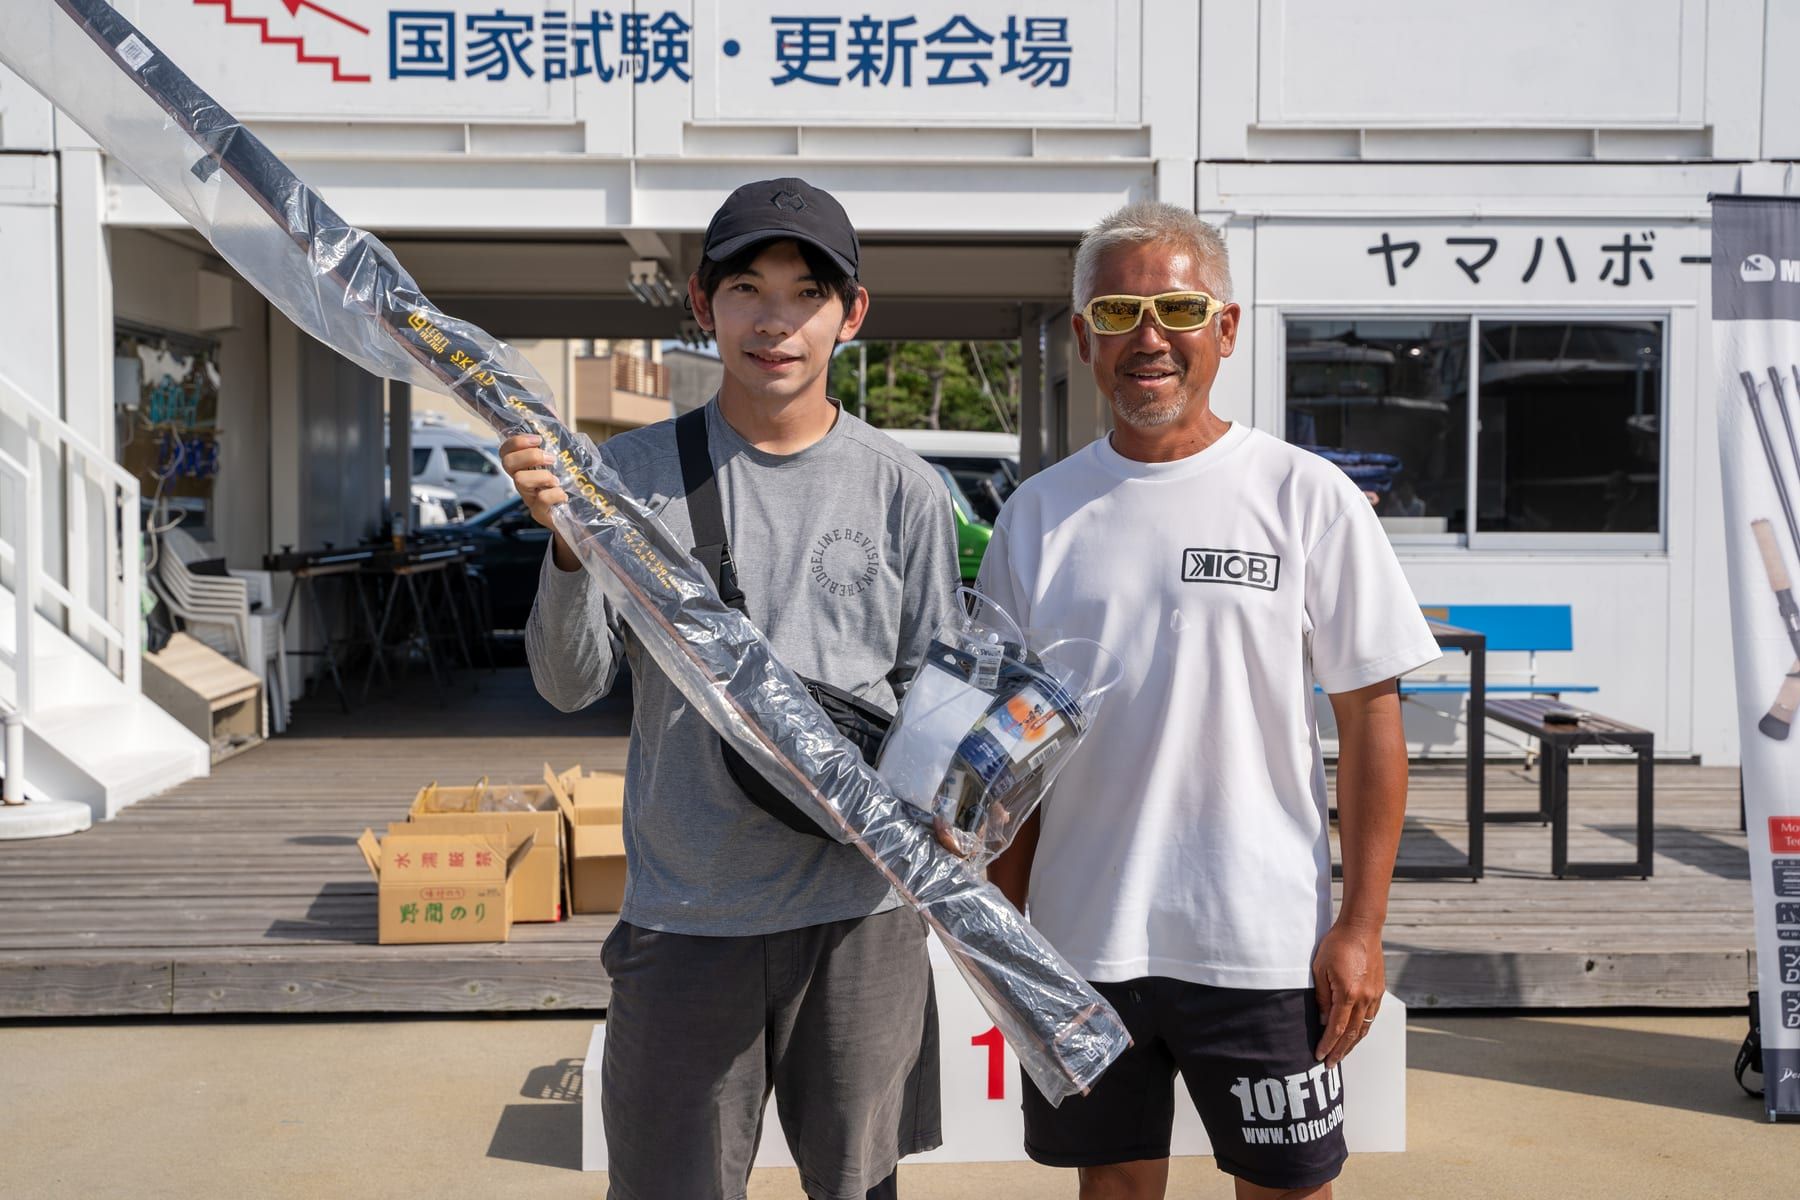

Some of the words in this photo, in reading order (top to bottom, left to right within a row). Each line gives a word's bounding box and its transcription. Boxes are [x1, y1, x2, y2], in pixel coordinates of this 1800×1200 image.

[388, 9, 1074, 87] 国家試験・更新会場
[399, 901, 486, 925] 野間のり
[971, 1026, 1005, 1100] 1
[1241, 1103, 1345, 1145] www.10ftu.com
